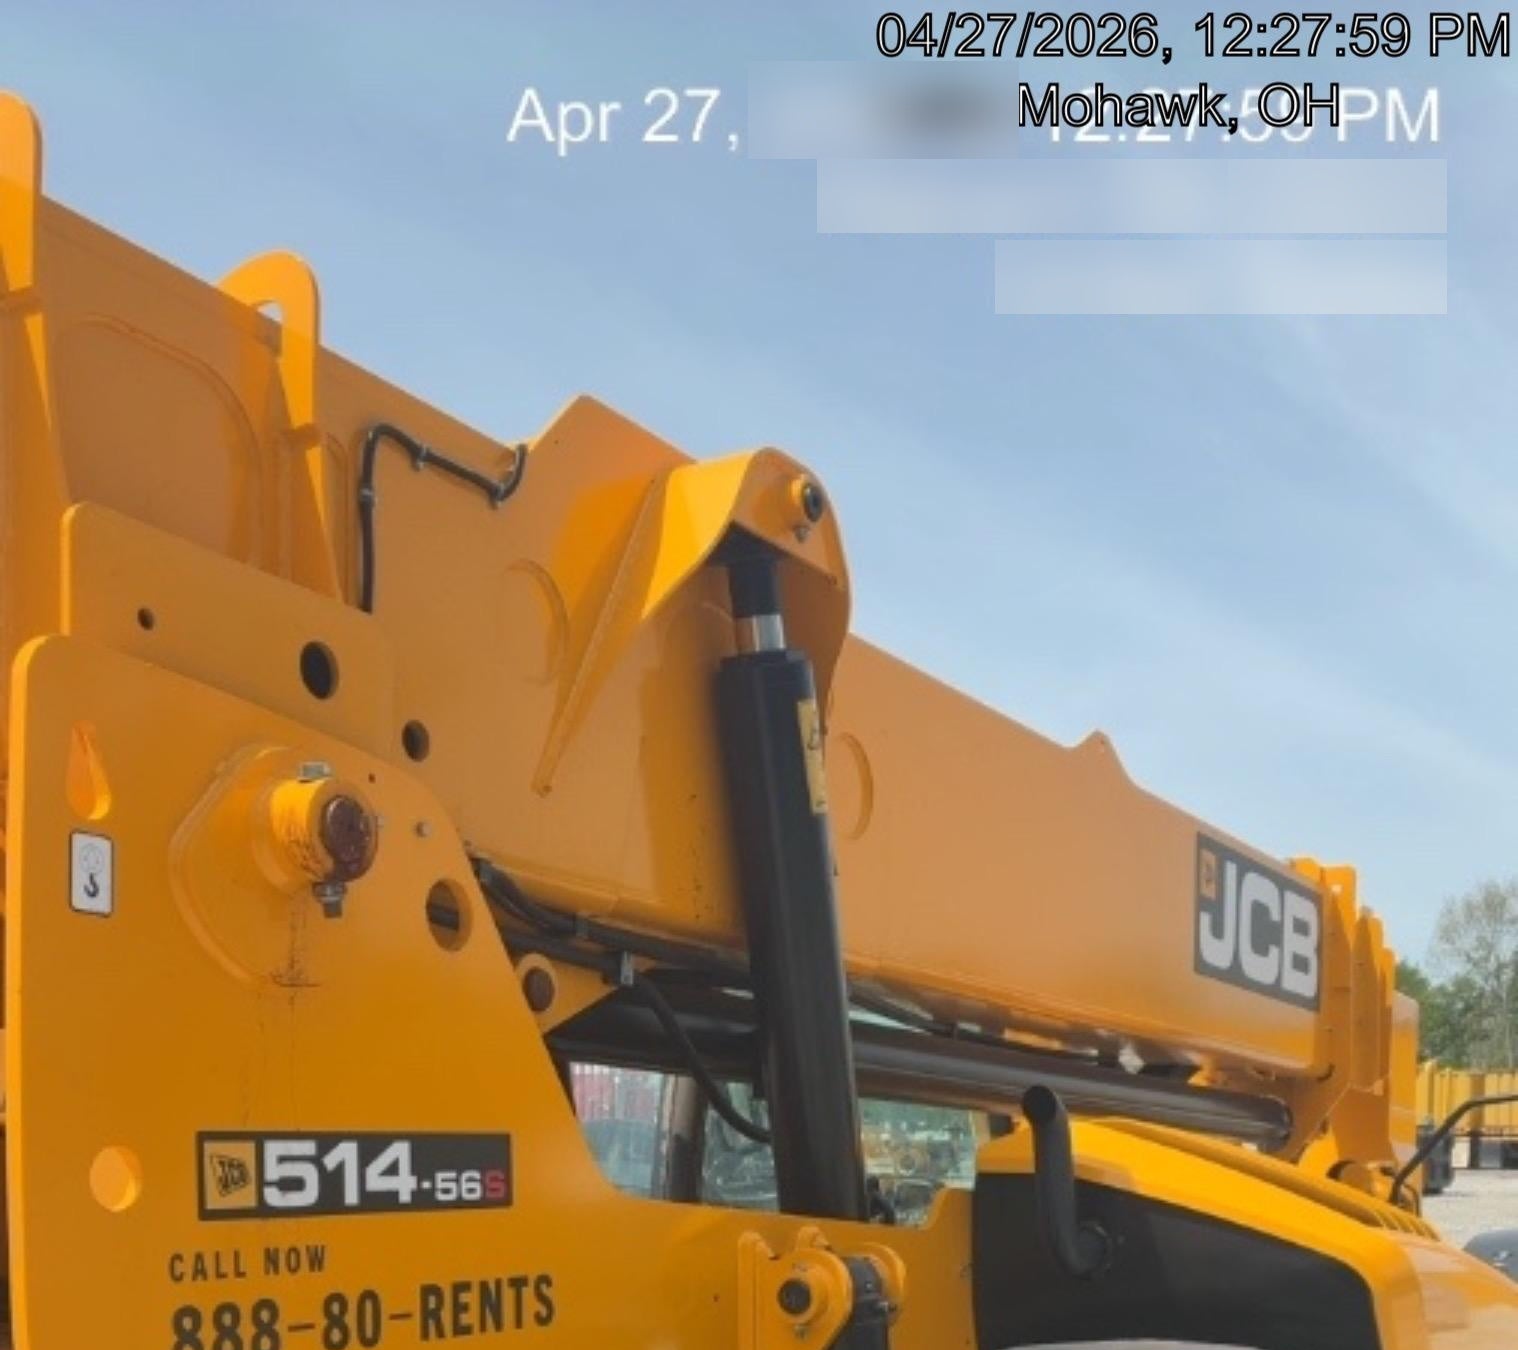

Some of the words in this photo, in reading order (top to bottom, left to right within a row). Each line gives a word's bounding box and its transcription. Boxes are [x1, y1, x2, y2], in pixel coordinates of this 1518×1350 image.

[1199, 860, 1319, 998] JCB
[169, 1251, 247, 1283] CALL
[264, 1245, 326, 1276] NOW
